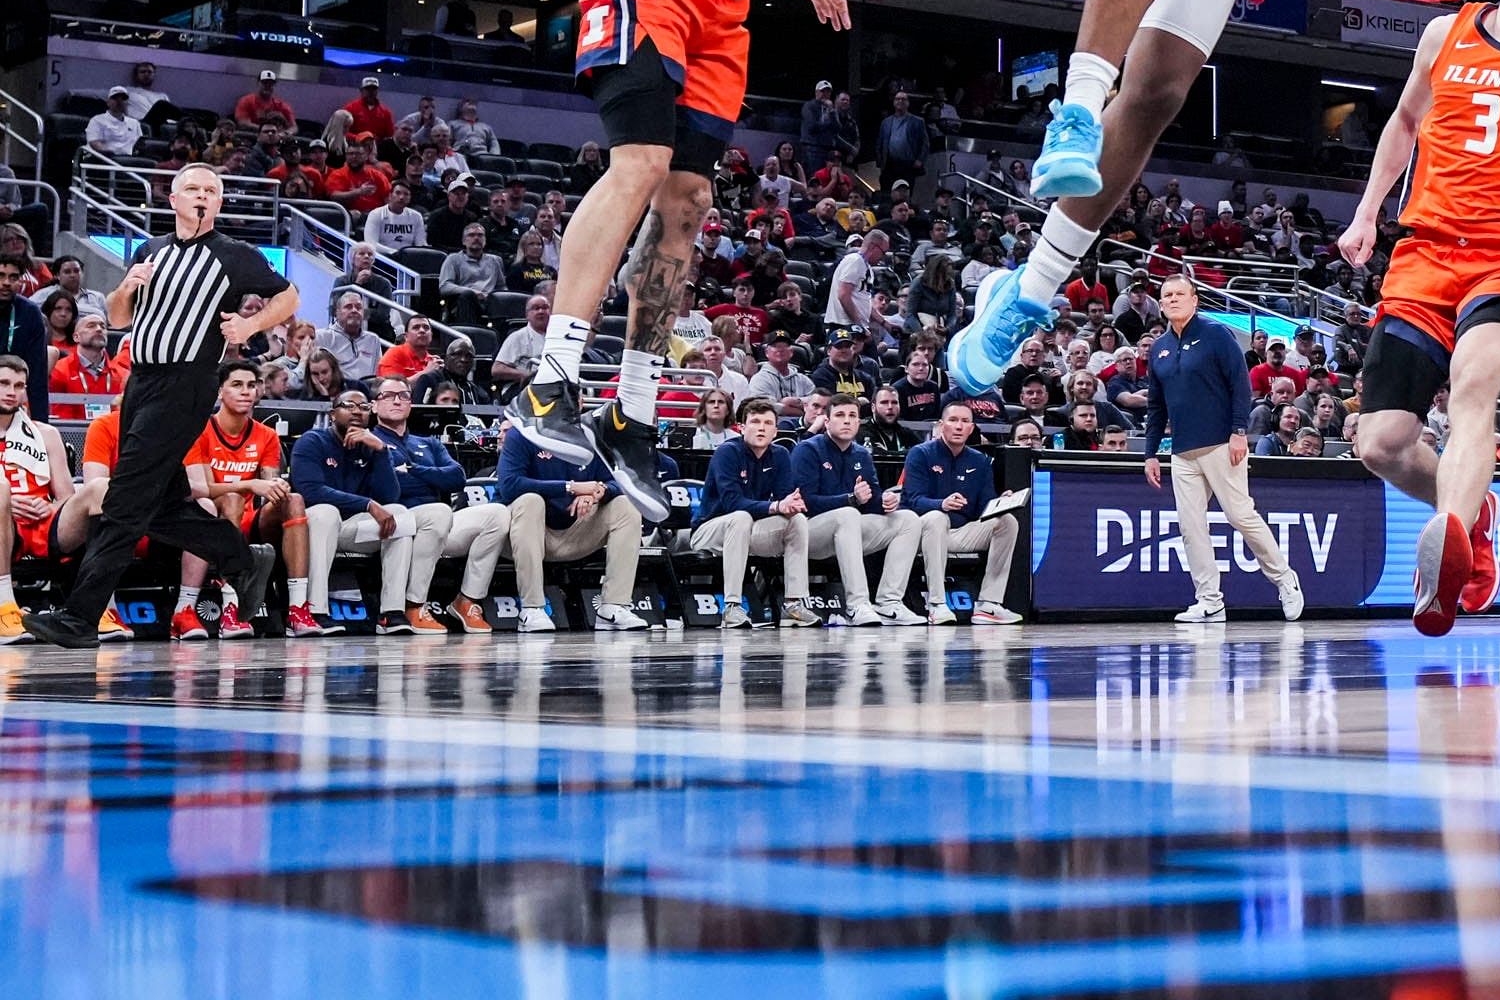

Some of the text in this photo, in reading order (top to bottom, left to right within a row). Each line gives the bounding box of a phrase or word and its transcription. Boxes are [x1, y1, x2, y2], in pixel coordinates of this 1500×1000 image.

[582, 4, 610, 47] I
[50, 62, 61, 87] 5
[672, 328, 706, 338] NUMBERS
[5, 440, 47, 462] ORADE
